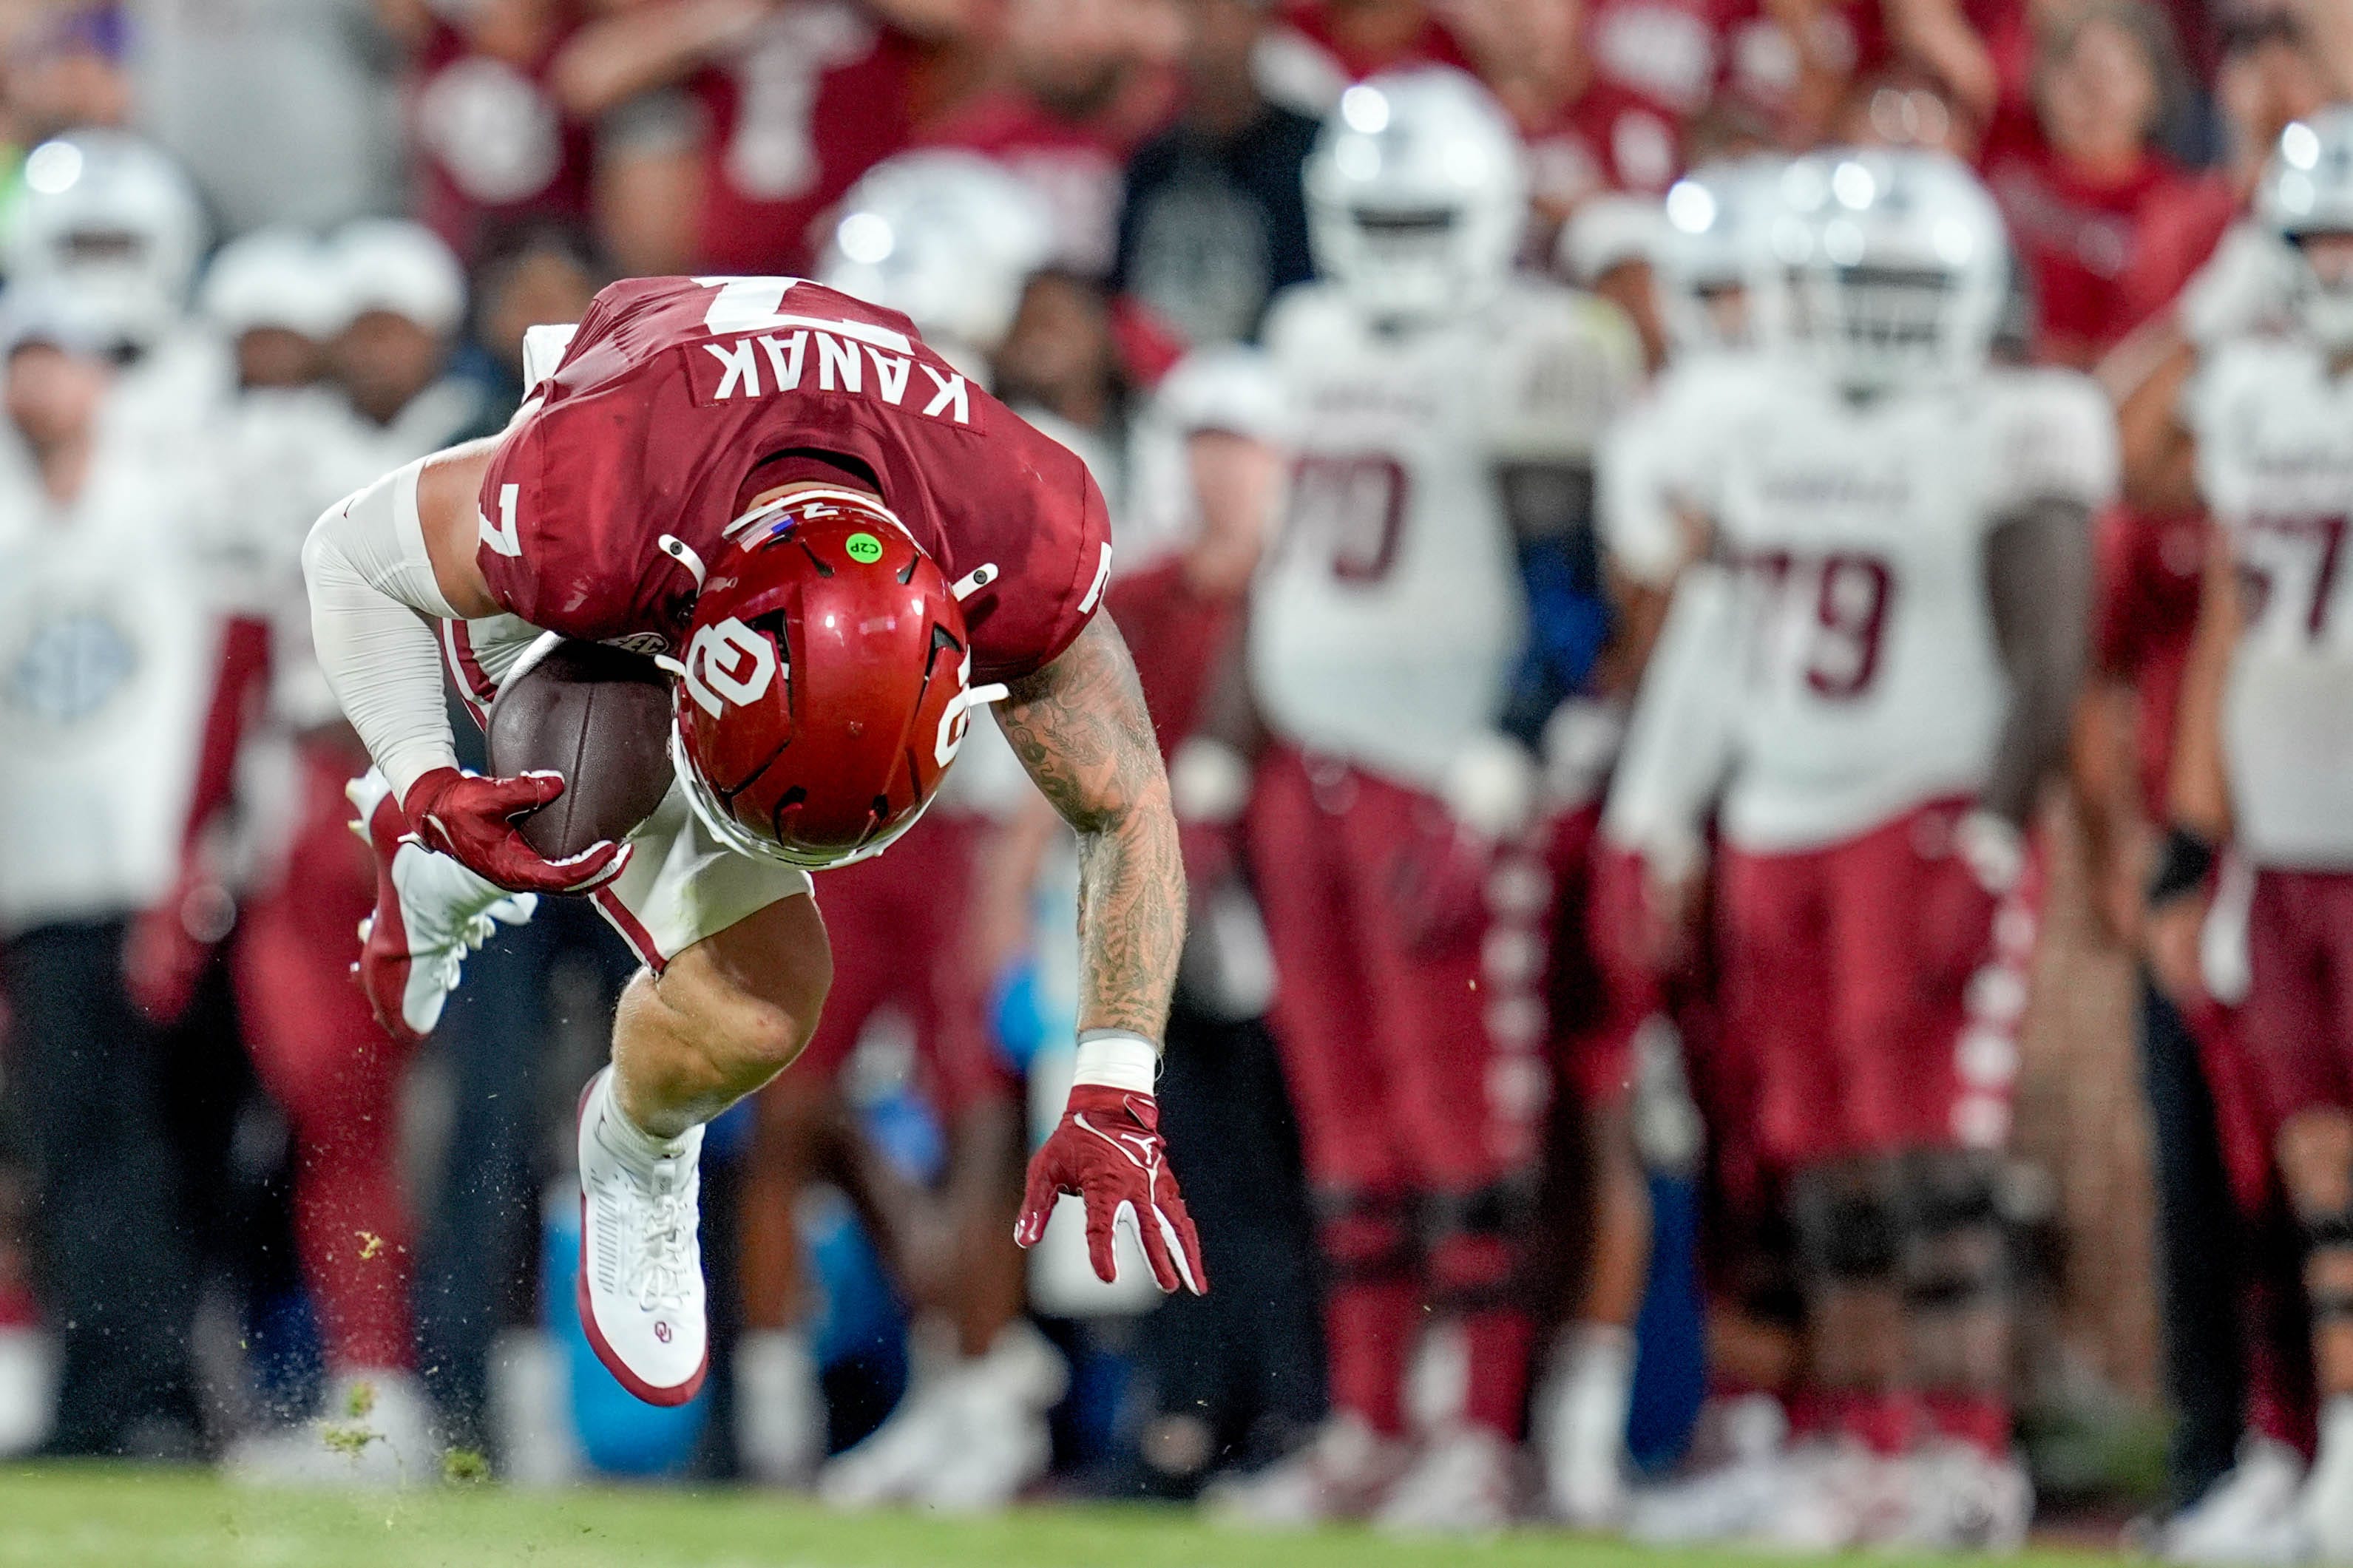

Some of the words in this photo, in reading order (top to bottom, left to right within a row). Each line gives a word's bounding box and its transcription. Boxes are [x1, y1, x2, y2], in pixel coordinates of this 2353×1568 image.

[702, 330, 969, 424] KANAK
[478, 483, 523, 557] 7
[850, 542, 879, 554] C2P
